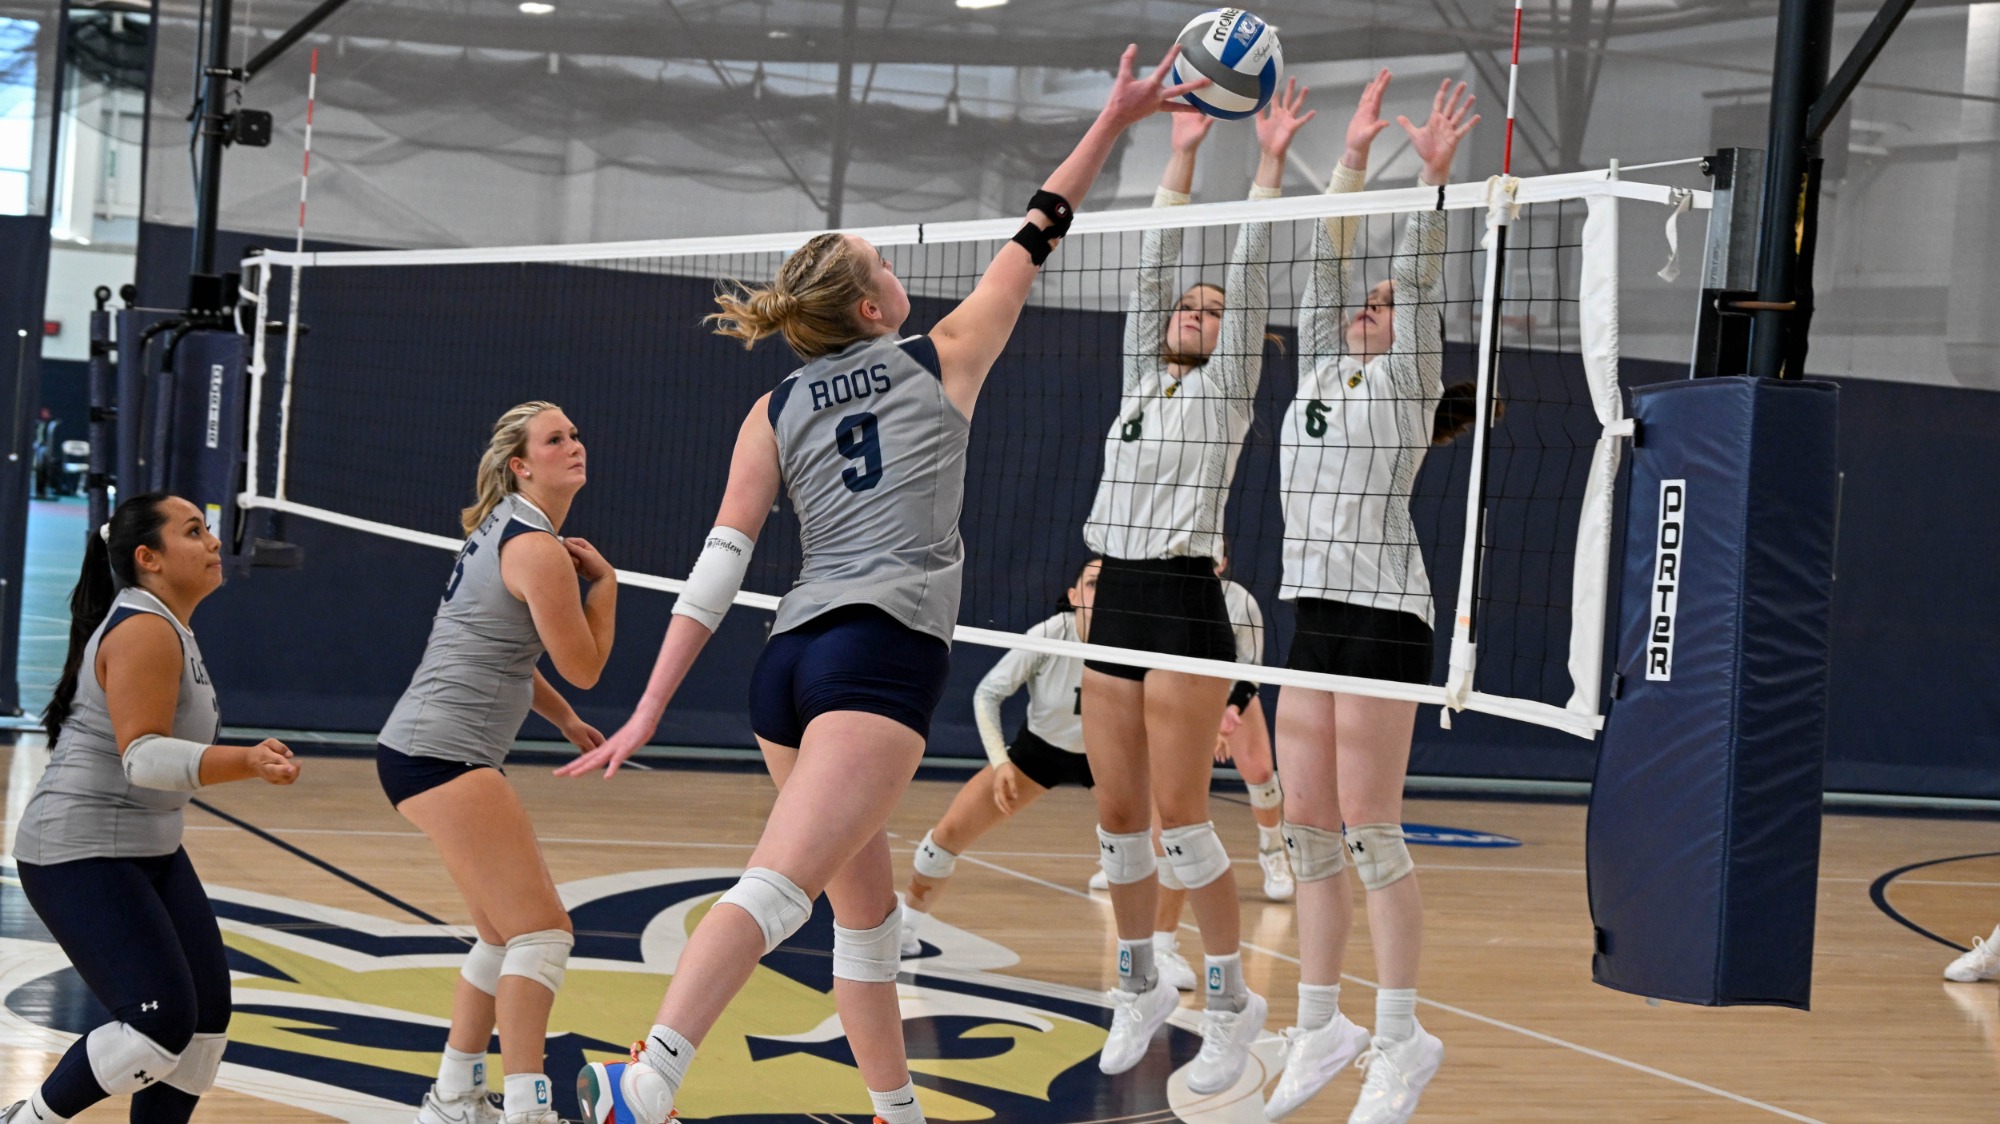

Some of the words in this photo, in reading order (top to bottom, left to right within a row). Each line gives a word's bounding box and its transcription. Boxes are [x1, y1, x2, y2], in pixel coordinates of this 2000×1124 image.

[808, 363, 891, 412] ROOS
[1306, 399, 1333, 438] 6
[835, 411, 883, 493] 9
